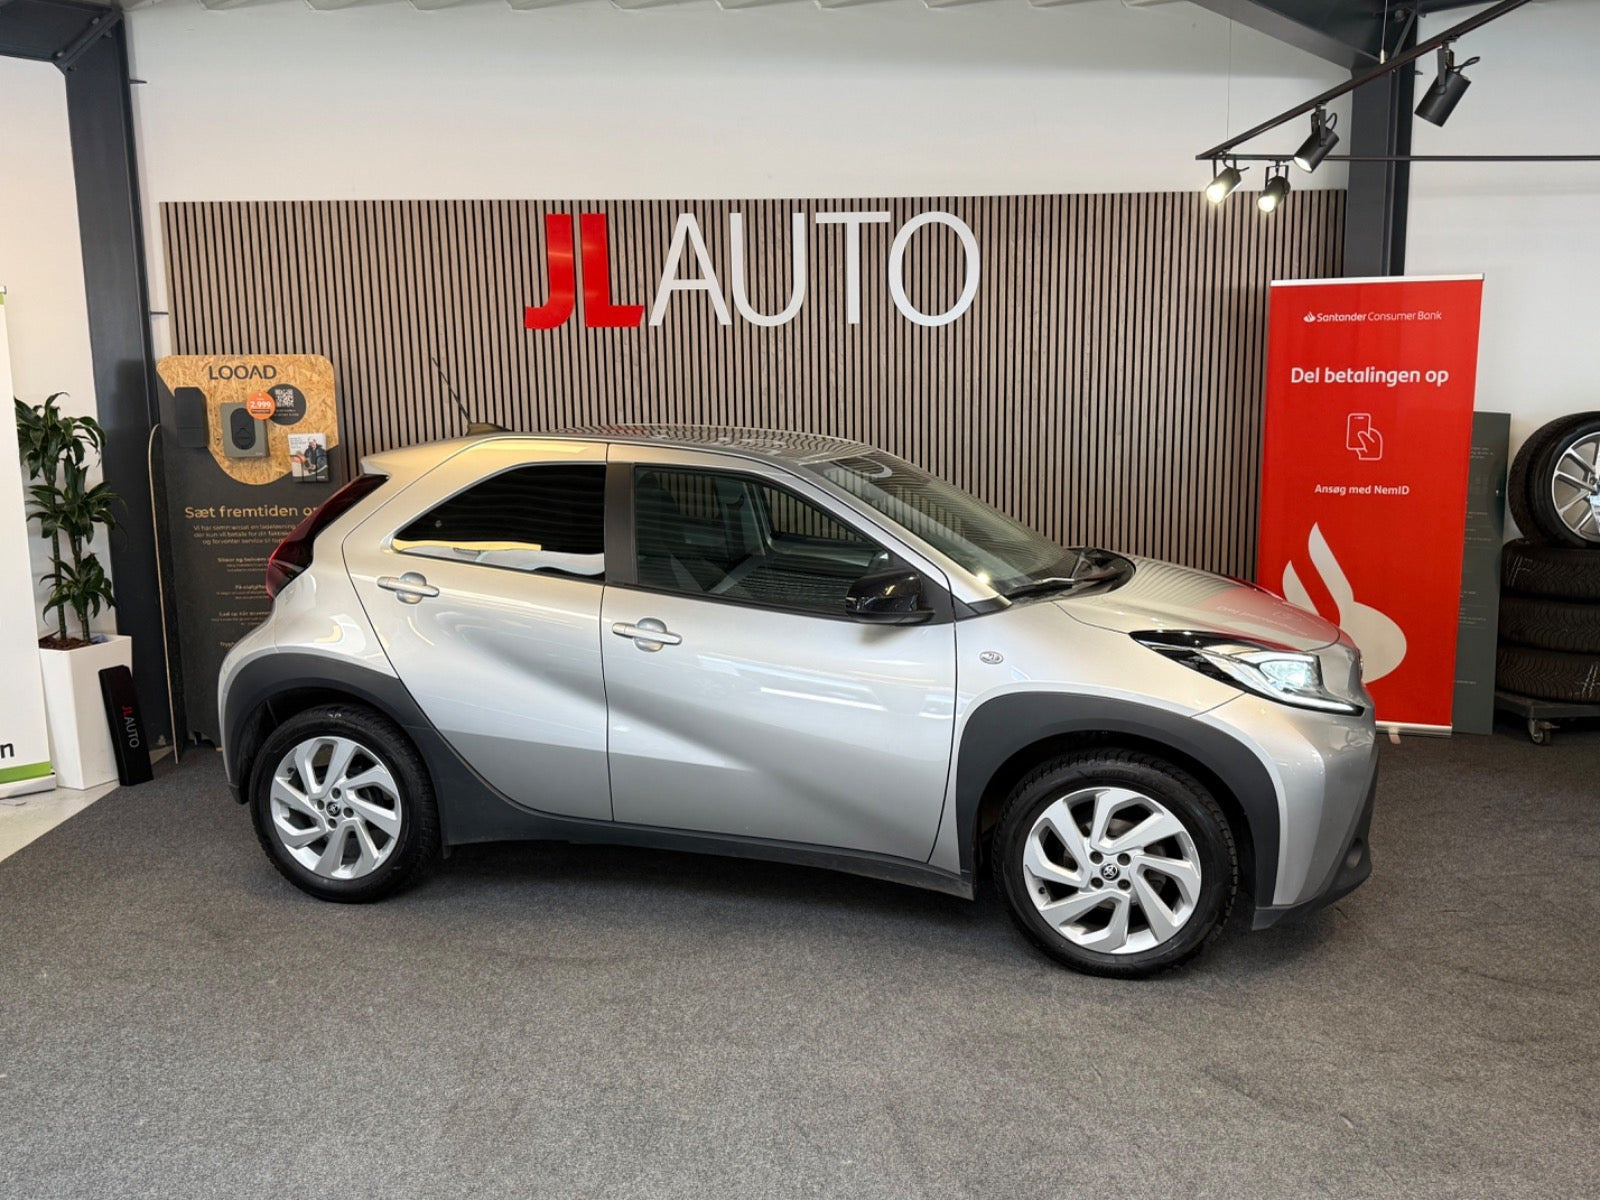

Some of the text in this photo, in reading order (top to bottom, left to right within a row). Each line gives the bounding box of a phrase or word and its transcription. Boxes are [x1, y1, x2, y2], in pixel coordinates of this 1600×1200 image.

[1317, 310, 1442, 323] Santander Consumer Bank
[208, 364, 277, 380] LOOAD
[1291, 366, 1449, 387] Del betalingen op
[1314, 484, 1410, 496] Ansøg med NemID
[184, 506, 216, 519] Sæt
[219, 505, 298, 518] fremtiden
